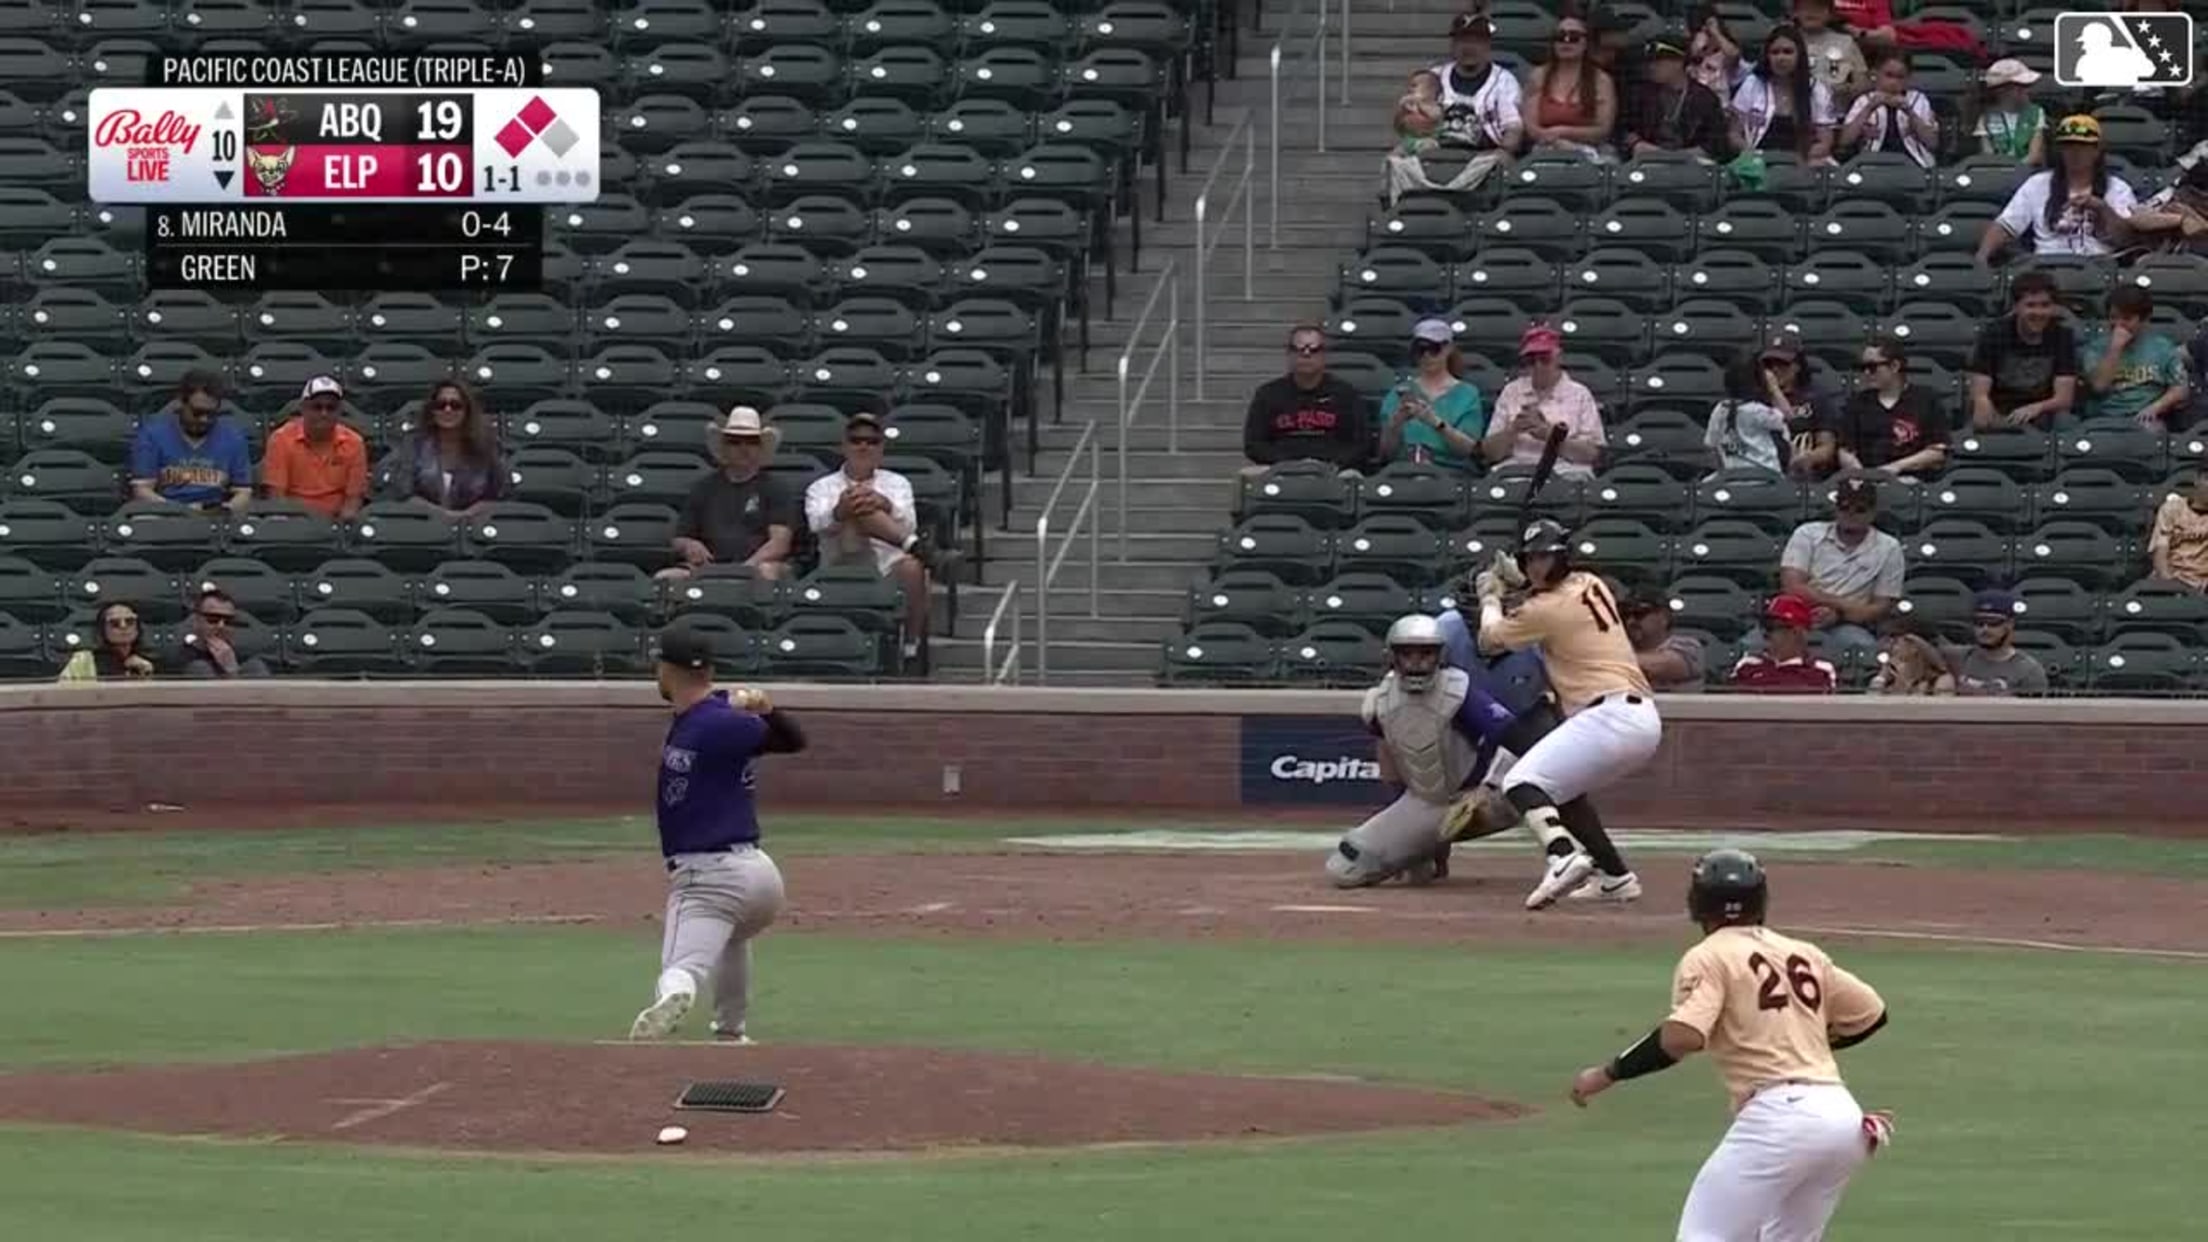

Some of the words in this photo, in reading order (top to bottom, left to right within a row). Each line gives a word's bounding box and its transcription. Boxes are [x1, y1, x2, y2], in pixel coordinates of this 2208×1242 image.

[1581, 583, 1620, 633] 11
[1270, 755, 1381, 784] Capita
[1748, 951, 1822, 1015] 26
